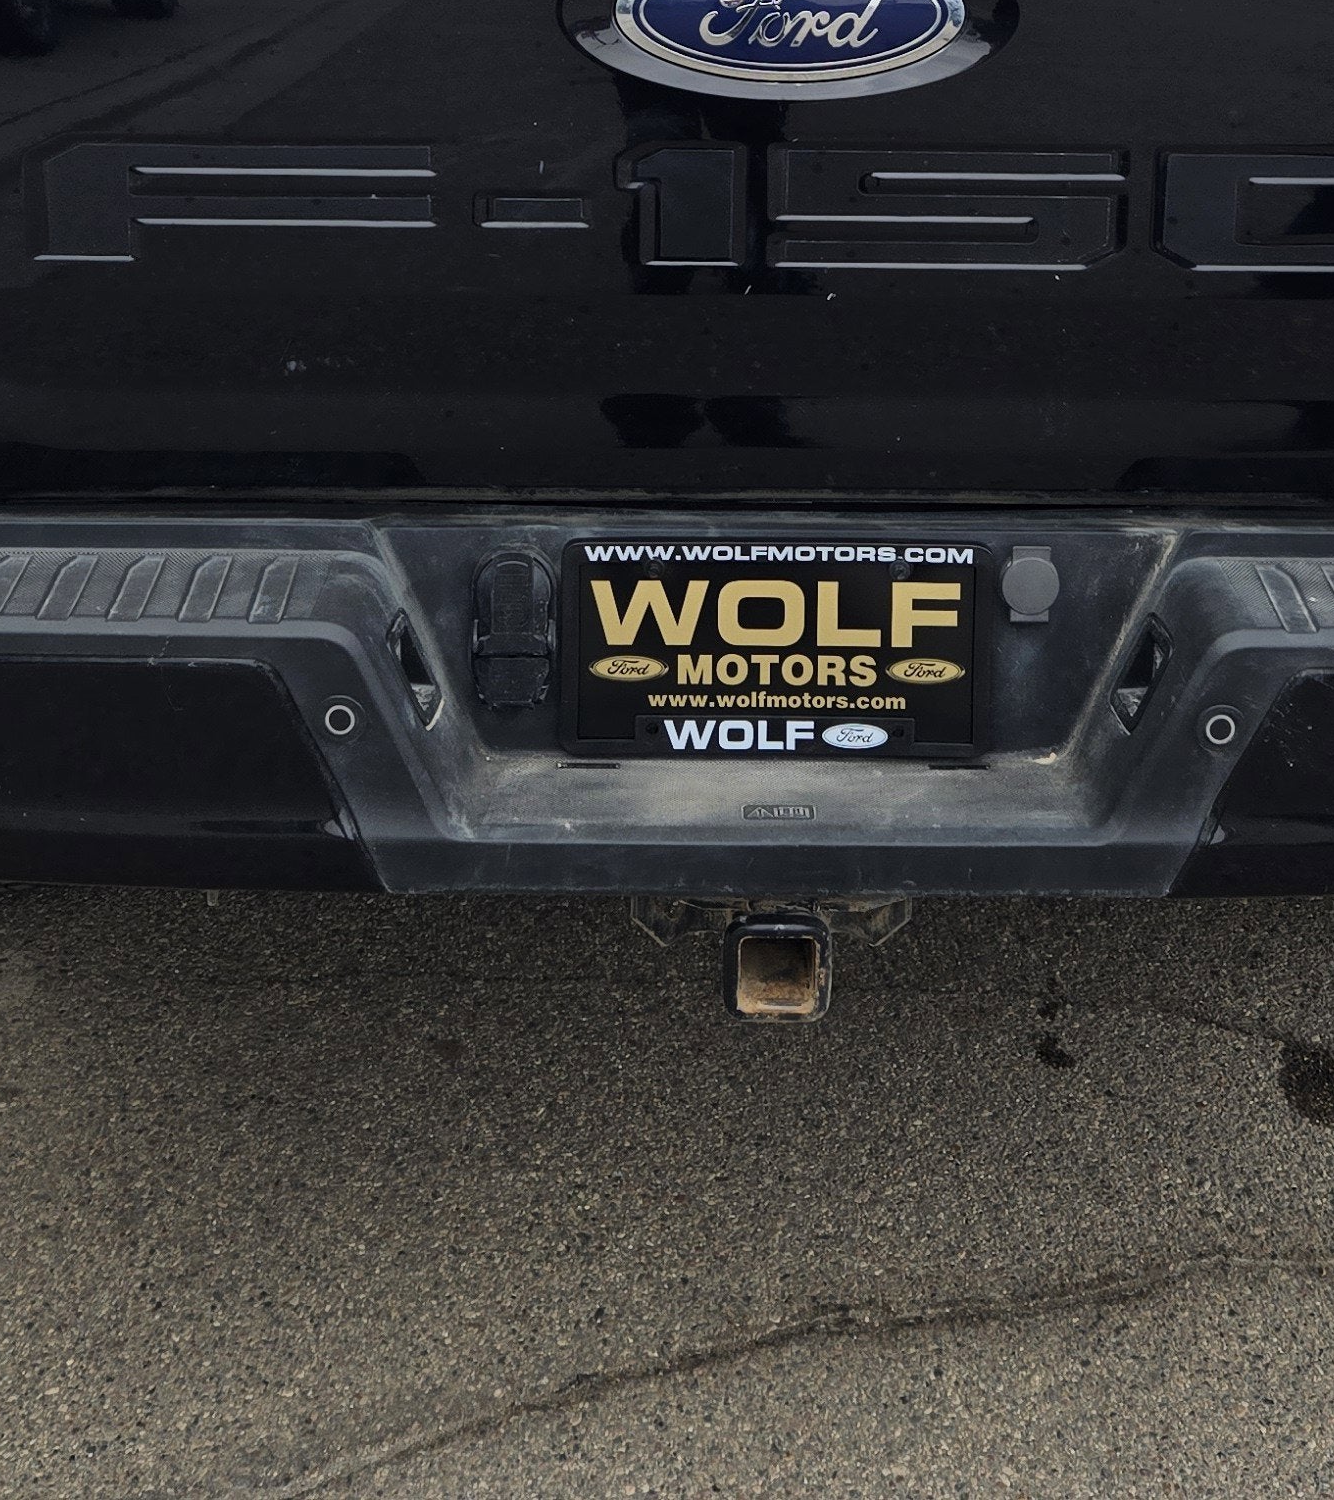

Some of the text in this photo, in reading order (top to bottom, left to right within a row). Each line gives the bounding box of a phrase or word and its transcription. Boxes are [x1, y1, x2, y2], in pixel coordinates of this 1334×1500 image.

[584, 545, 974, 565] WWW.WOLFMOTORS.COM
[590, 580, 961, 648] WOLF
[607, 653, 947, 687] Ford MOTORS Ford
[648, 691, 906, 710] www.wolfmotors.com
[663, 719, 873, 750] WOLF Ford
